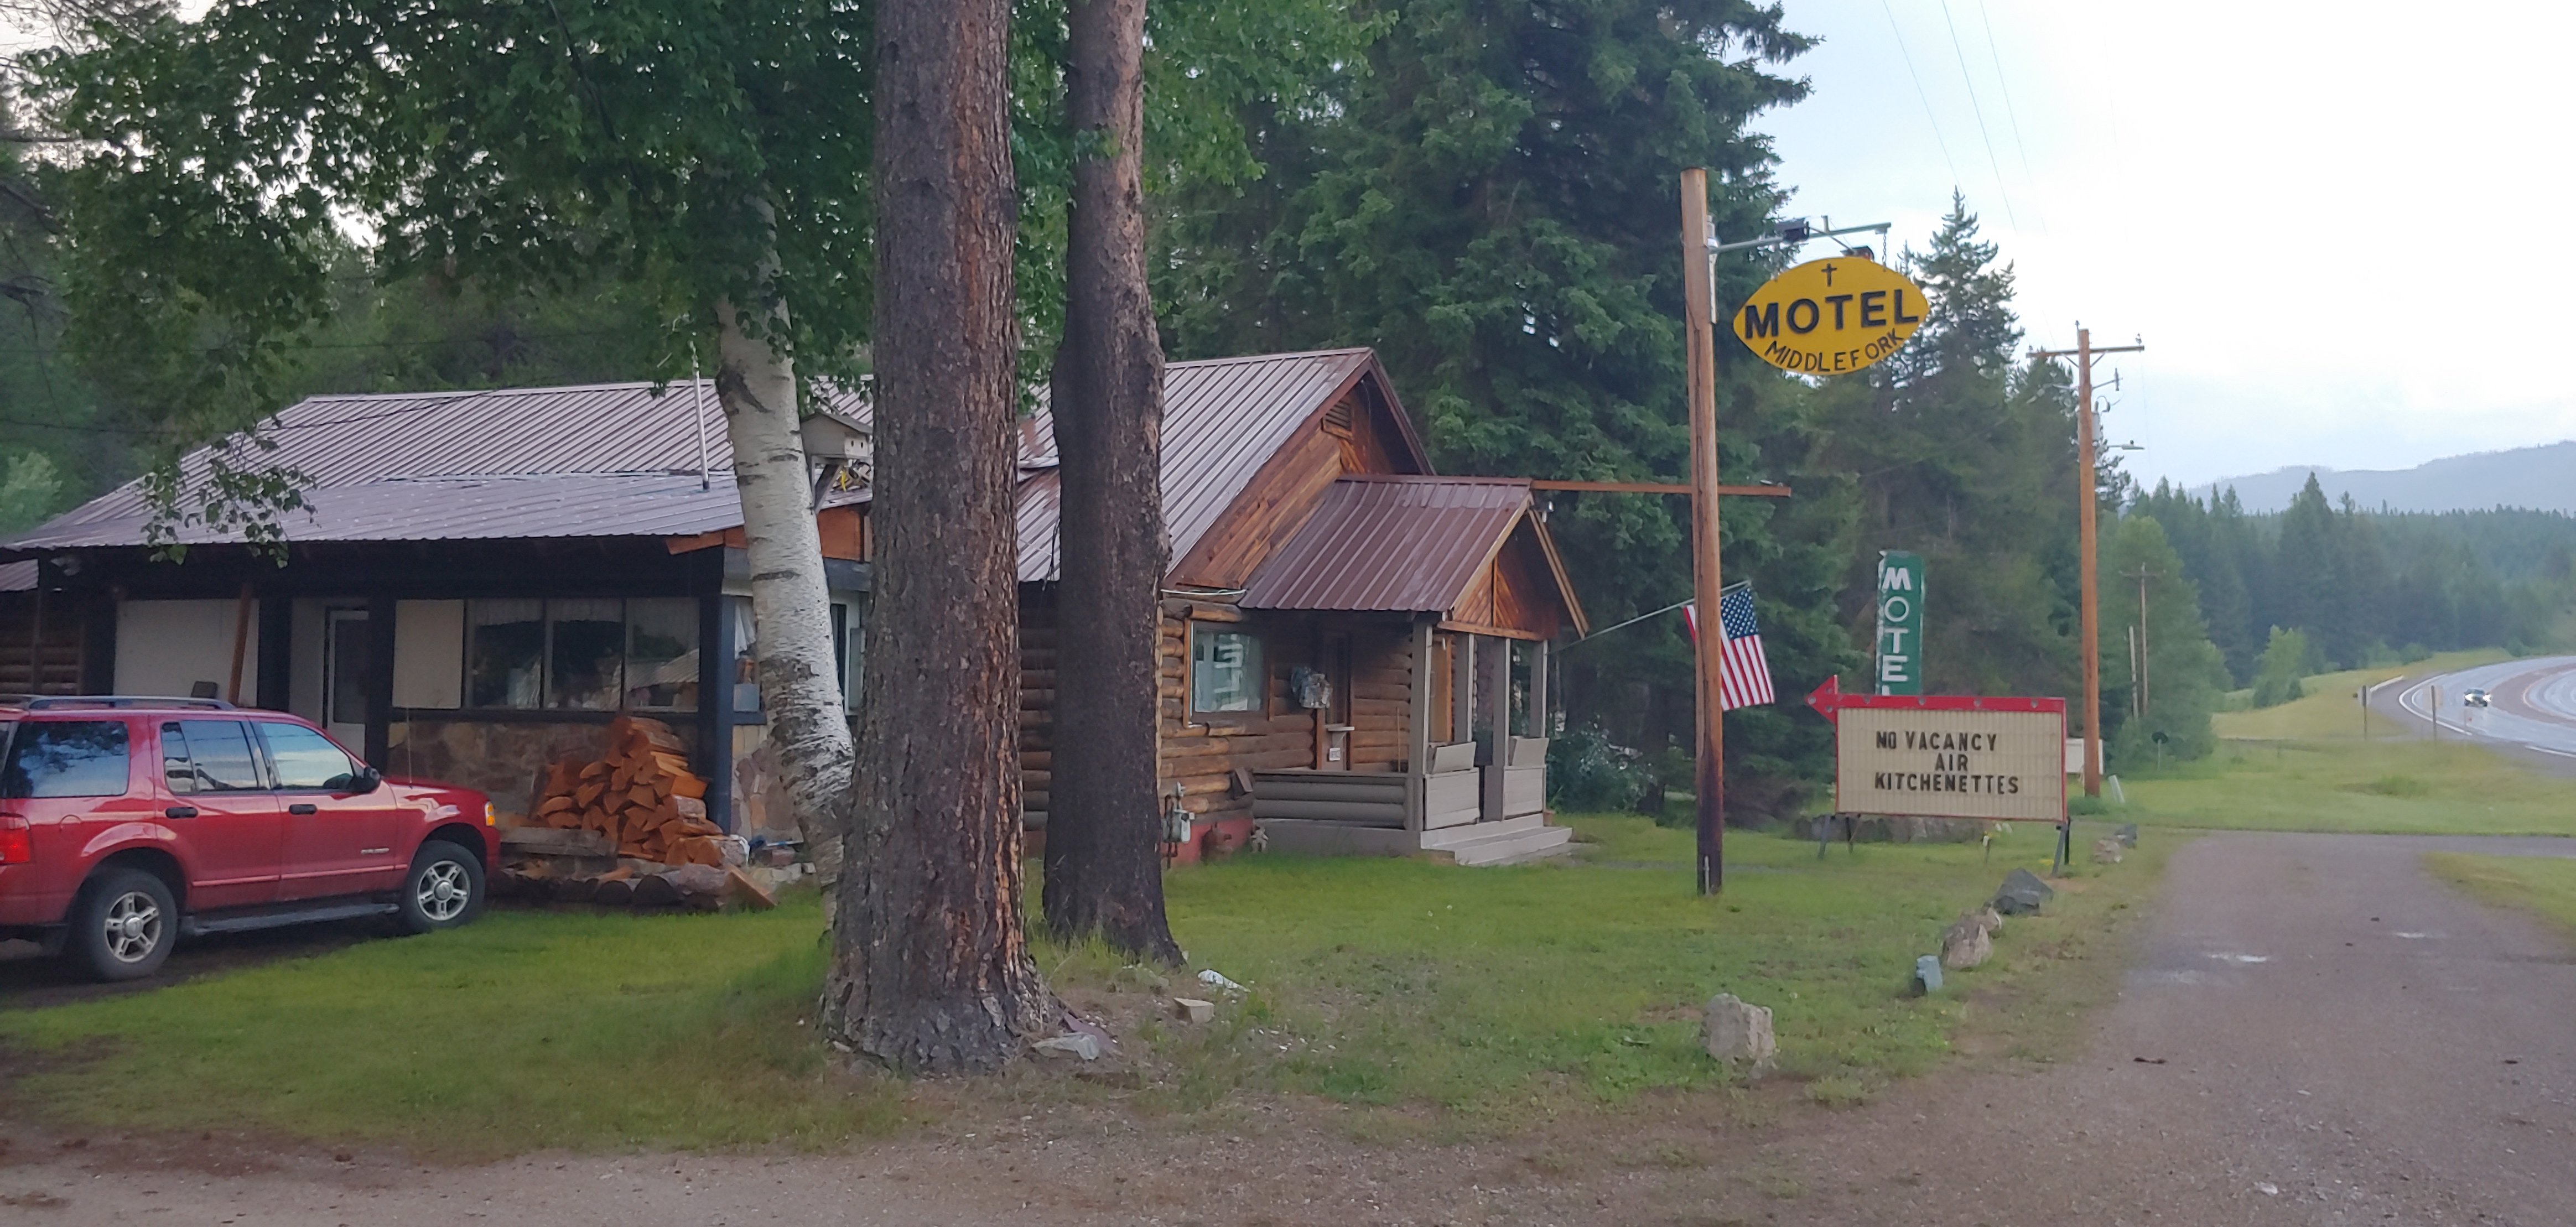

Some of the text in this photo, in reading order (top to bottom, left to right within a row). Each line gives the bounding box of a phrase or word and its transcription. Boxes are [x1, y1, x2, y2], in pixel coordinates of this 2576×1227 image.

[1744, 289, 1919, 340] MOTEL
[1876, 731, 1997, 752] NO VACANCY
[1935, 753, 1969, 772] AIR
[1874, 772, 2019, 795] KITCHENETTES
